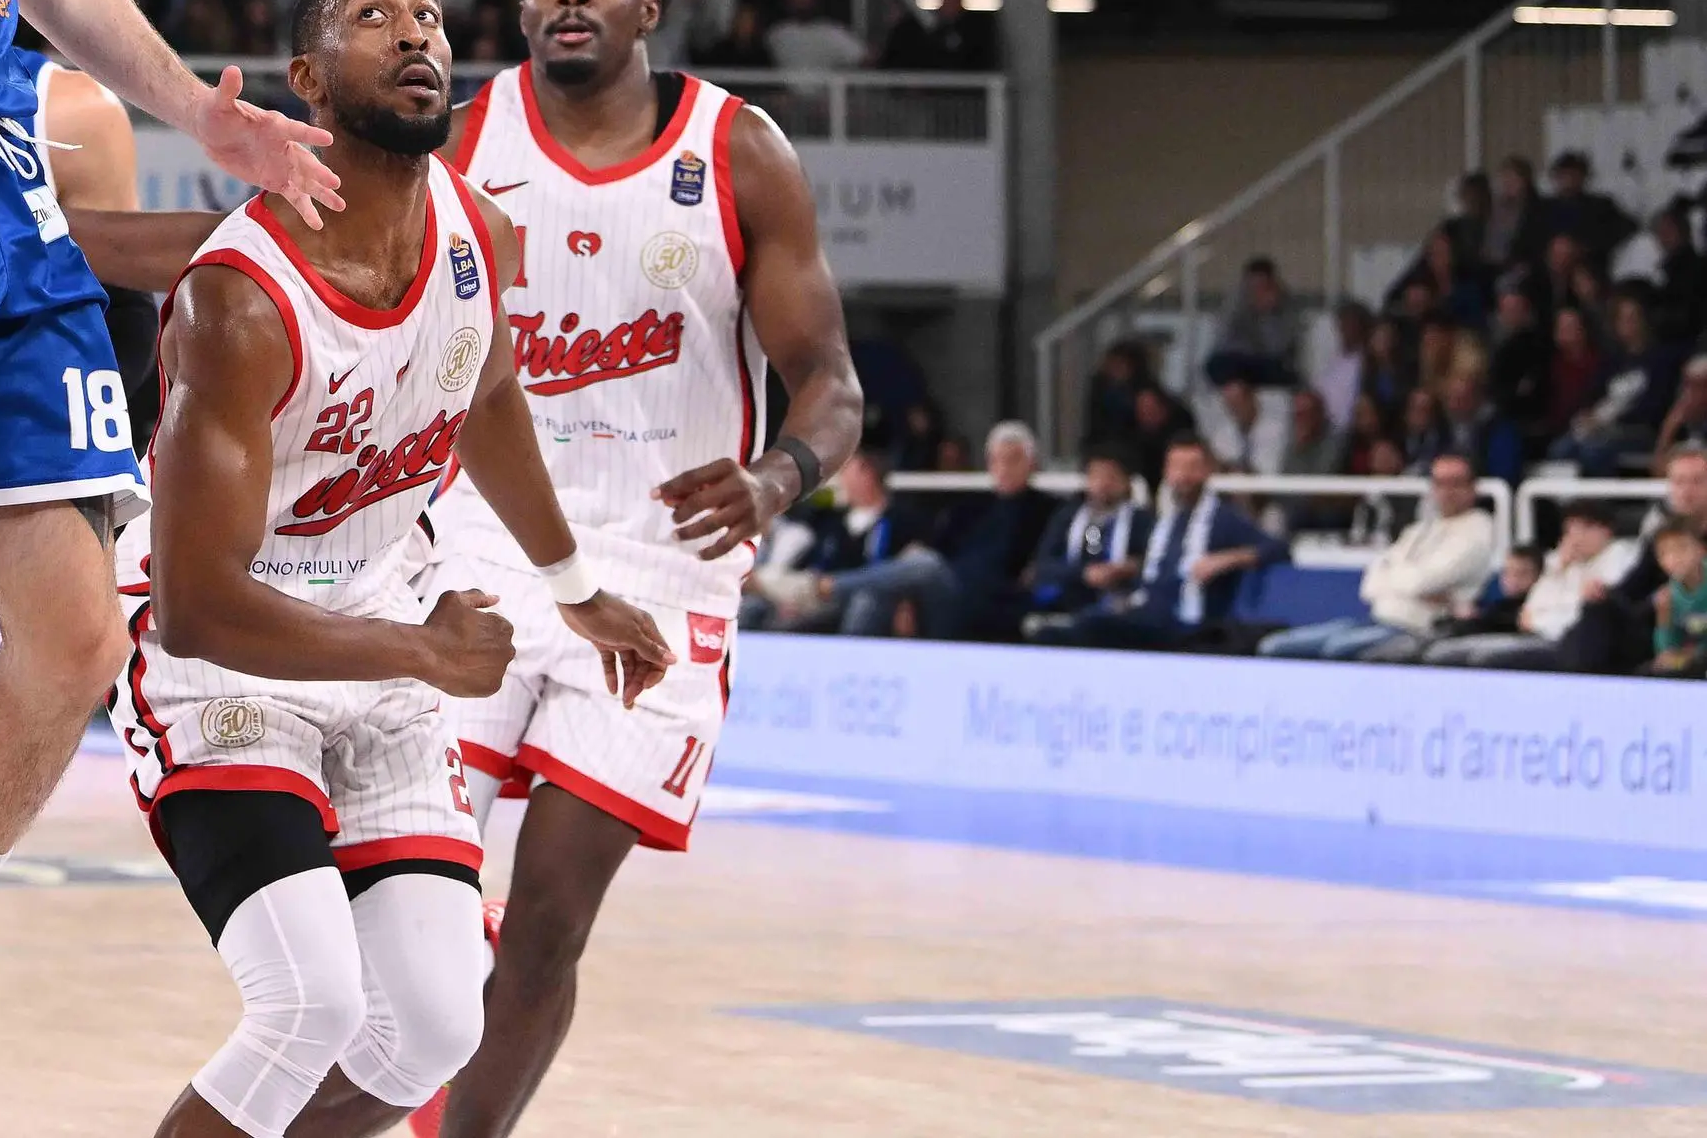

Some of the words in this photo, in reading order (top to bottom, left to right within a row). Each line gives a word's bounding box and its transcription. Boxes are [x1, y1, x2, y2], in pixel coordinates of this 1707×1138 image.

[454, 258, 475, 275] LBA
[460, 280, 477, 294] Unipol
[507, 308, 685, 379] Trieste
[61, 367, 132, 452] 18
[304, 386, 375, 455] 22
[295, 560, 343, 575] FRIULI
[219, 707, 248, 737] 50
[1420, 710, 1606, 790] d'arredo
[1618, 723, 1693, 795] dal
